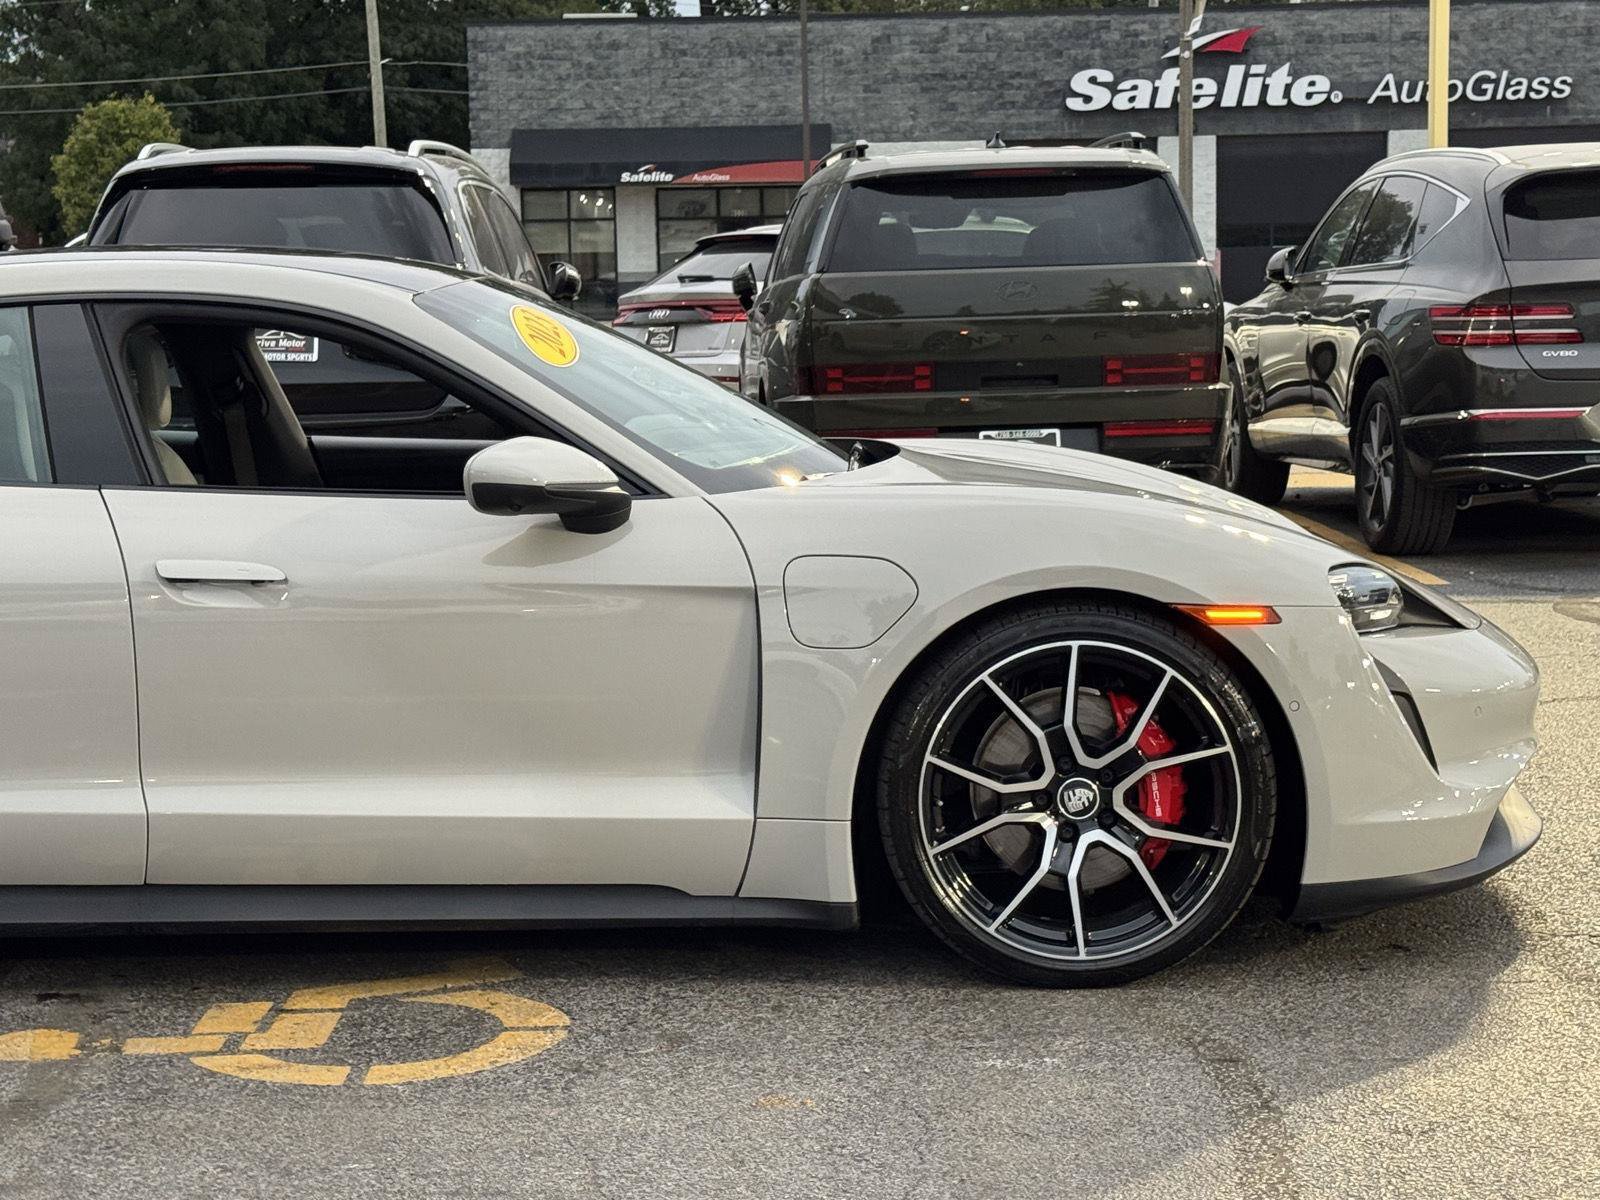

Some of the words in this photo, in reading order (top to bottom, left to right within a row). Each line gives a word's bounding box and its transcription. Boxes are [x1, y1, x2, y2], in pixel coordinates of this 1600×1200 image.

[1367, 70, 1573, 104] AuoGlass
[620, 171, 673, 182] Safelite
[256, 339, 277, 348] rive
[278, 339, 306, 348] Motor
[1542, 349, 1579, 357] GV80
